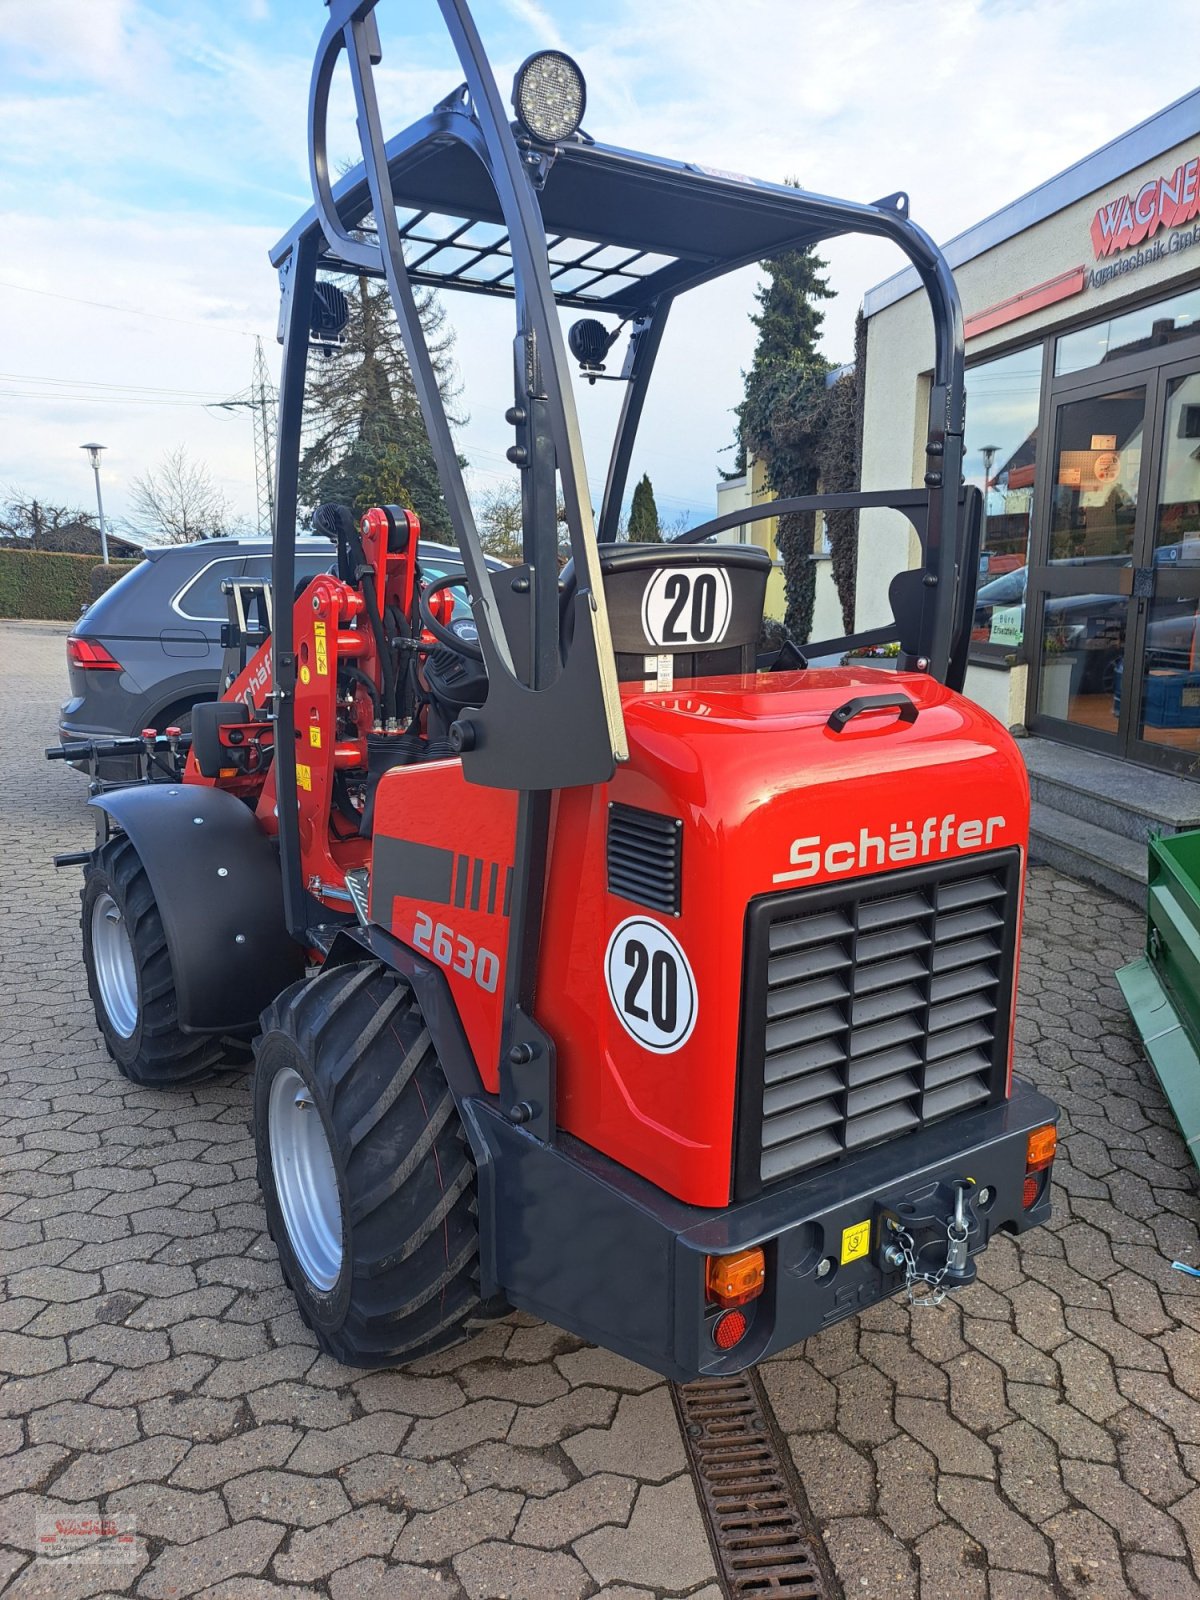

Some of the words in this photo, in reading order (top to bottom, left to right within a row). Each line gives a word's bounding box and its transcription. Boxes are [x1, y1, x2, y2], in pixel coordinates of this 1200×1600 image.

[1091, 157, 1200, 255] WAGNE
[1086, 241, 1167, 289] Agrartechnik
[662, 573, 717, 643] 20
[772, 814, 1006, 884] Schäffer
[412, 910, 500, 994] 2630
[624, 939, 678, 1033] 20
